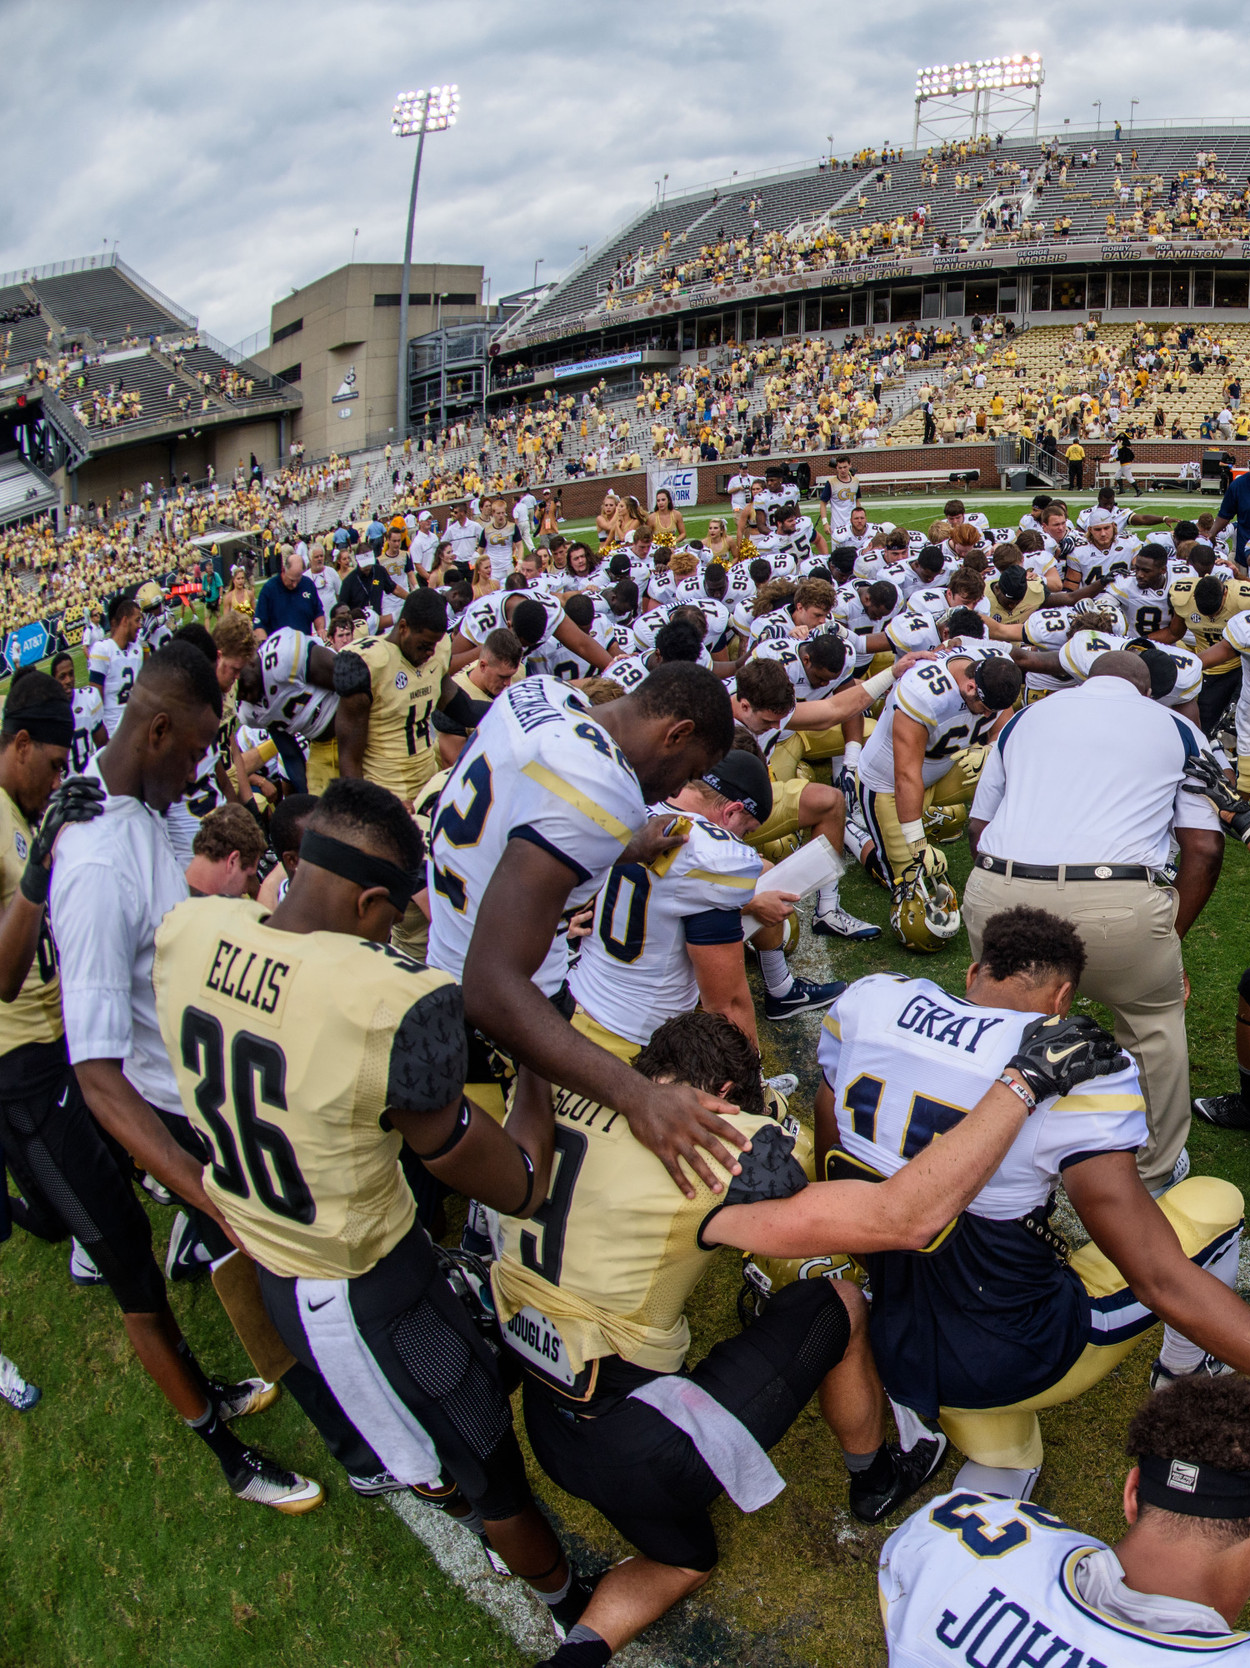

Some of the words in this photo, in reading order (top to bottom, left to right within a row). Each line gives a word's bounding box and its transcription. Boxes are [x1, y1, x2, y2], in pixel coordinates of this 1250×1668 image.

[1017, 249, 1049, 257] GEORGE
[1018, 254, 1067, 265] MORRIS
[1102, 250, 1141, 260] DAVIS
[1155, 249, 1225, 259] HAMILTON
[933, 256, 958, 265] MAXIE
[934, 259, 993, 272] BAUGHAN
[831, 266, 856, 275] COLLEGE
[857, 261, 900, 271] FOOTBALL
[821, 275, 853, 287] HALL
[854, 272, 873, 281] OF
[874, 266, 912, 280] FAME
[689, 295, 718, 308] SHAW
[601, 316, 629, 327] GUYON
[562, 325, 586, 337] FAME
[663, 473, 693, 486] ACC
[1040, 610, 1066, 632] 83
[23, 634, 43, 652] AT&T
[917, 665, 953, 696] 65
[404, 700, 433, 757] 14
[206, 940, 289, 1014] ELLIS
[897, 995, 1004, 1053] GRAY
[180, 1005, 316, 1226] 36
[506, 1319, 561, 1363] DOUGLAS
